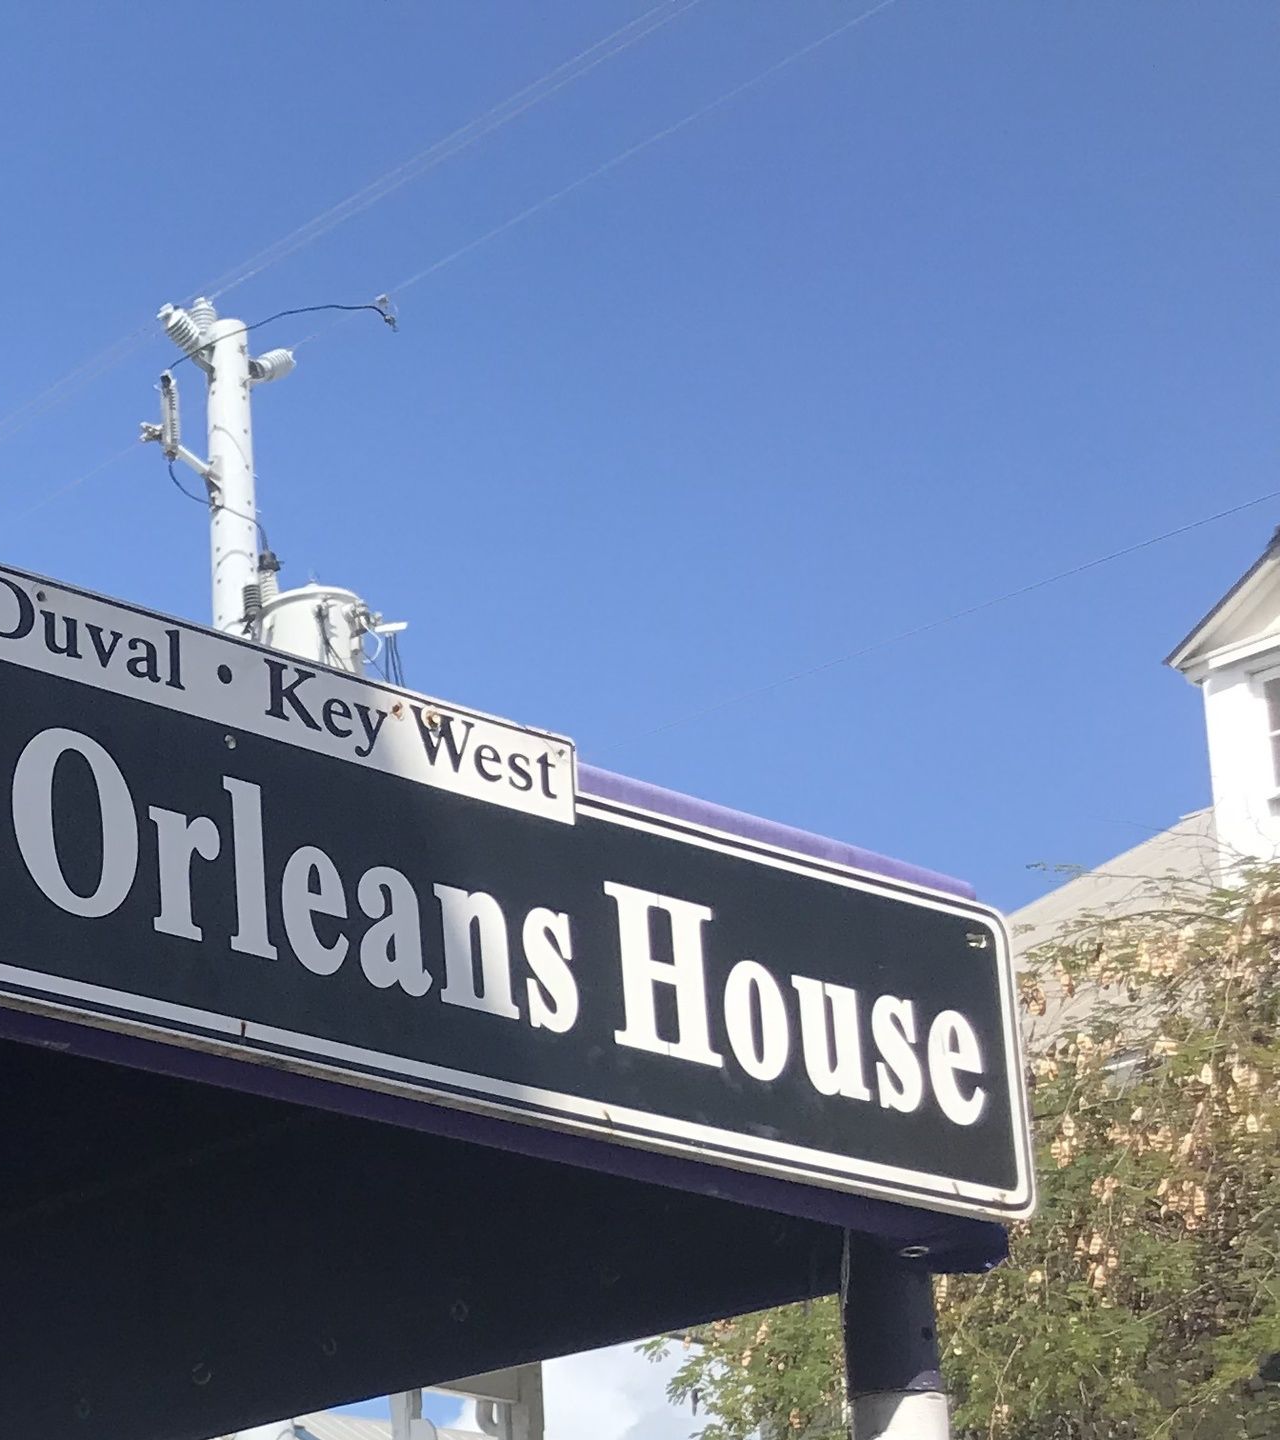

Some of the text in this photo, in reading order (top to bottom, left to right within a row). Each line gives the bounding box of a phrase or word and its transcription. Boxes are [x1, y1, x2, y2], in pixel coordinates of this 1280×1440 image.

[264, 658, 389, 757] Key
[408, 705, 558, 799] West
[11, 727, 580, 1033] Orleans
[603, 881, 986, 1126] House
